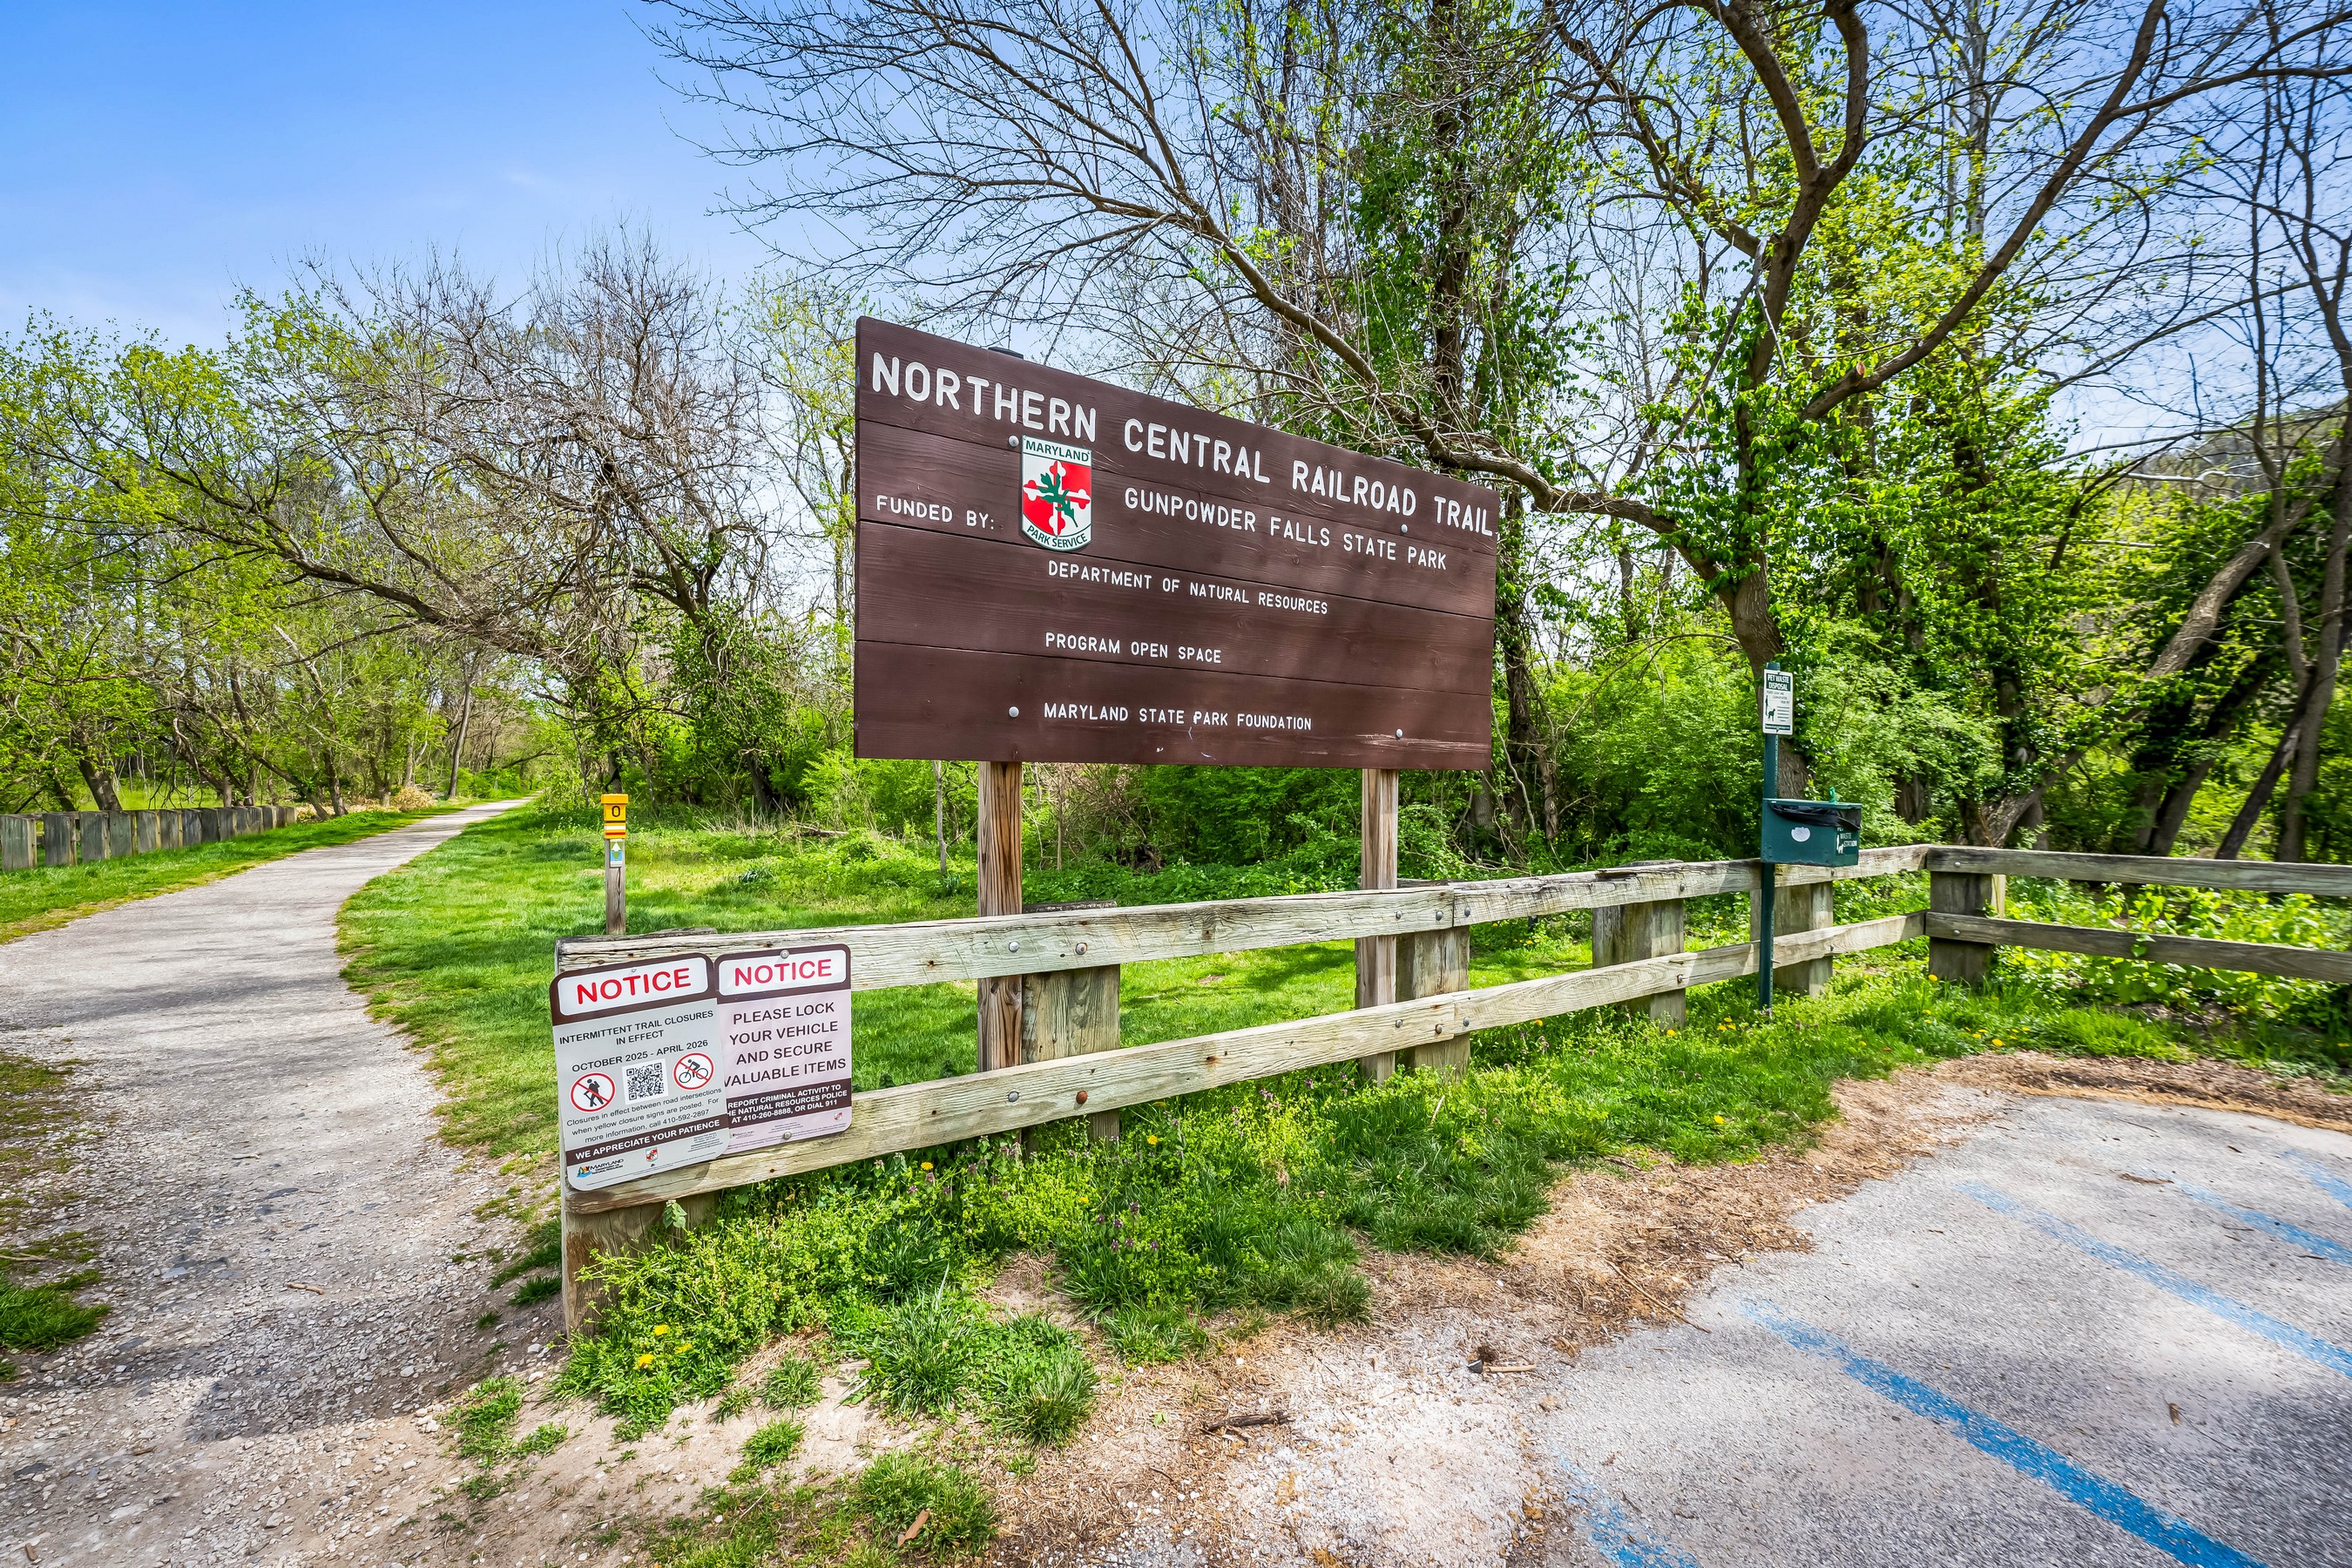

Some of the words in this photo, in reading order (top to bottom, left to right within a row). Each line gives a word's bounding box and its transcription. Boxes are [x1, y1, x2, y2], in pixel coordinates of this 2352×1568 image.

[872, 352, 1097, 443] NORTHERN
[1124, 418, 1270, 483] CENTRAL
[1292, 460, 1416, 517] RAILROAD
[1434, 496, 1493, 537] TRAIL
[1025, 440, 1089, 462] MARYLAND
[876, 495, 953, 523] FUNDED
[966, 510, 995, 531] BY:
[1027, 524, 1051, 545] PARK
[1051, 533, 1088, 548] SERVICE
[1125, 487, 1256, 532] GUNPOWDER
[1270, 517, 1330, 547] FALLS
[1342, 533, 1396, 561] STATE
[1407, 545, 1447, 571] PARK
[1048, 560, 1152, 590] DEPARTMENT
[1162, 578, 1180, 592] OF
[1190, 582, 1250, 604] NATURAL
[1259, 592, 1328, 615] RESOURCES
[1045, 632, 1120, 654] PROGRAM
[1131, 641, 1168, 659] OPEN
[1178, 646, 1222, 664] SPACE
[1775, 675, 1789, 684] WASTE
[1044, 702, 1129, 722] MARYLAND
[1139, 708, 1185, 725] STATE
[1193, 711, 1228, 727] PARK
[1237, 713, 1312, 731] FOUNDATION
[577, 967, 692, 1004] NOTICE
[734, 958, 832, 987] NOTICE
[559, 1024, 632, 1044] INTERMITTENT
[635, 1020, 662, 1031] TRAIL
[665, 1010, 713, 1025] CLOSURES
[733, 1007, 791, 1024] PLEASE
[796, 1002, 835, 1017] LOCK
[616, 1037, 625, 1045] IN
[628, 1030, 665, 1044] EFFECT
[729, 1030, 772, 1045] YOUR
[776, 1021, 838, 1039] VEHICLE
[571, 1055, 623, 1072] OCTOBER
[625, 1051, 648, 1062] 2025
[656, 1044, 684, 1056] APRIL
[686, 1039, 708, 1051] 2026
[736, 1051, 769, 1064] AND
[774, 1041, 833, 1059] SECURE
[724, 1065, 800, 1087] VALUABLE
[804, 1058, 846, 1074] ITEMS
[566, 1114, 599, 1126] Closures
[610, 1108, 630, 1118] effect
[632, 1102, 661, 1112] between
[663, 1096, 679, 1105] road
[679, 1087, 722, 1102] intersections
[727, 1097, 760, 1109] REPORT
[760, 1092, 796, 1103] CRIMINAL
[797, 1086, 830, 1097] ACTIVITY
[738, 1104, 774, 1115] NATURAL
[774, 1096, 820, 1108] RESOURCES
[821, 1090, 848, 1100] POLICE
[794, 1104, 807, 1112] OR
[808, 1100, 824, 1110] DIAL
[572, 1126, 592, 1136] when
[594, 1120, 617, 1132] yellow
[618, 1115, 645, 1125] closure
[646, 1111, 665, 1121] signs
[679, 1101, 704, 1113] posted.
[707, 1097, 720, 1105] For
[585, 1134, 604, 1143] more
[605, 1124, 648, 1138] information,
[662, 1109, 710, 1125] 410-592-2897
[575, 1152, 591, 1160] WE
[592, 1135, 651, 1156] APPRECIATE
[652, 1128, 678, 1141] YOUR
[679, 1119, 720, 1136] PATIENCE
[590, 1159, 625, 1171] MARYLAND
